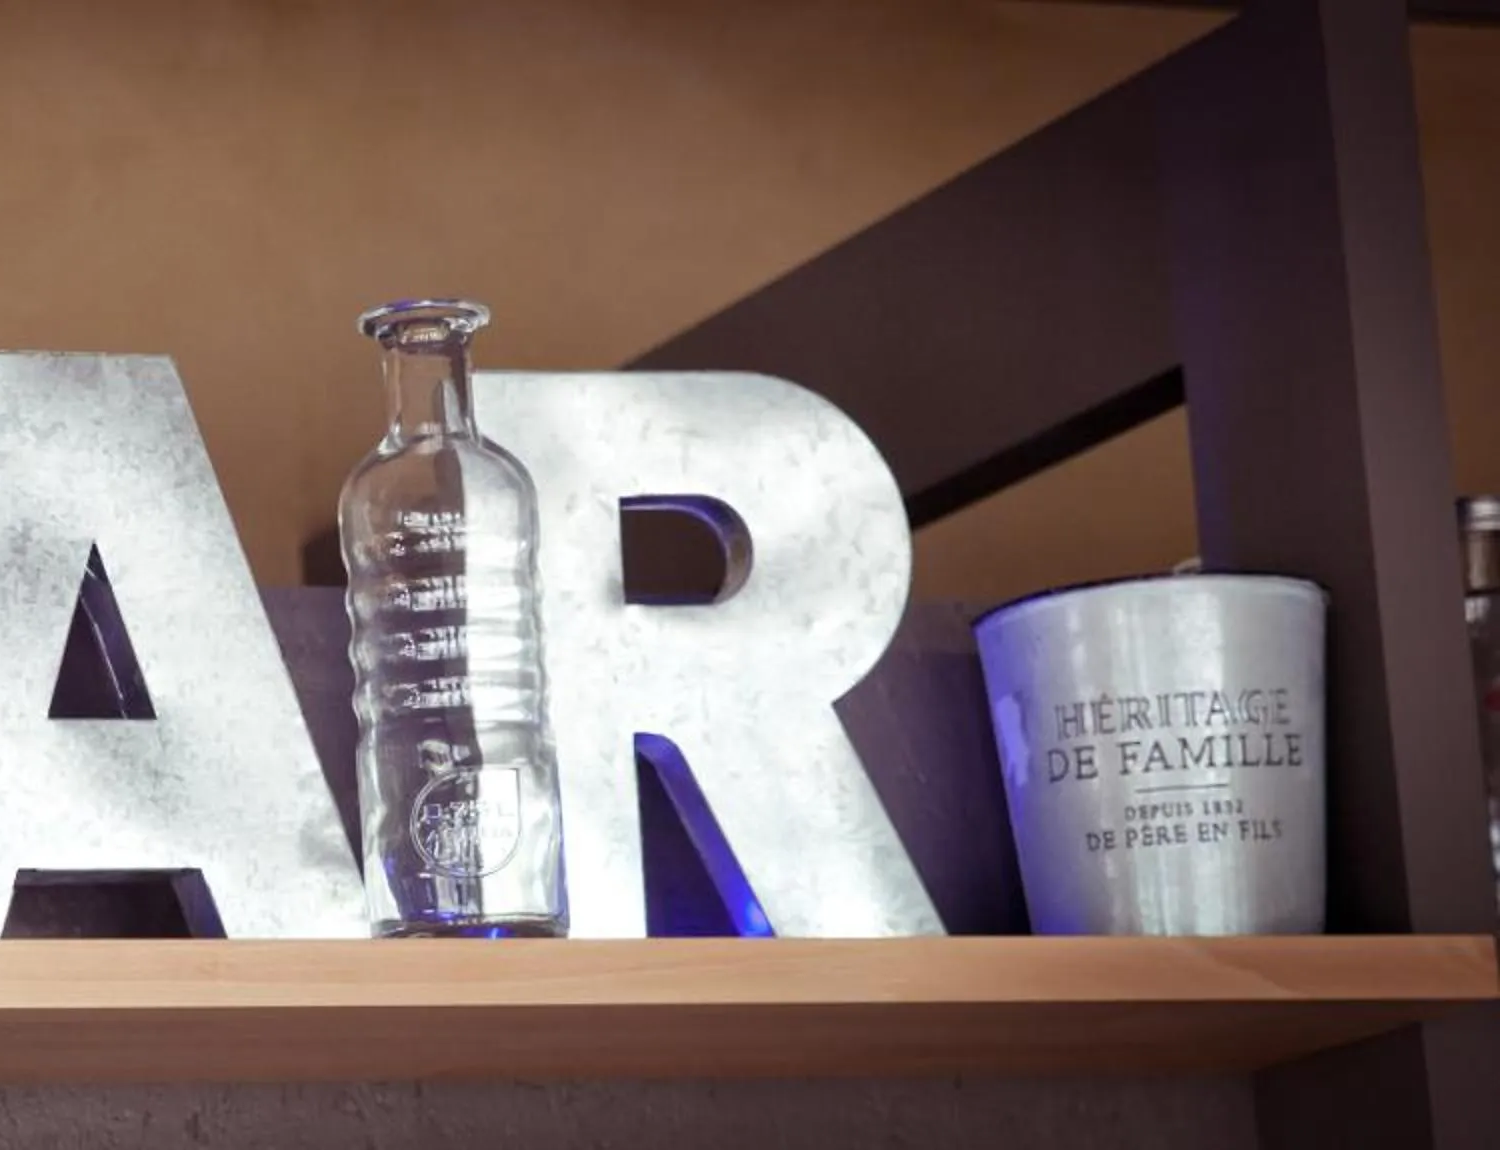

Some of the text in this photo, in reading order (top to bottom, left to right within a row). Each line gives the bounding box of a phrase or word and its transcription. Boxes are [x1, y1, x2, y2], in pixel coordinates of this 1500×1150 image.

[1054, 688, 1291, 740] HÉRITAGE
[1048, 732, 1304, 784] DE FAMILLE
[1124, 802, 1194, 822] DEPUIS
[1085, 817, 1283, 852] DE PÈRE EN FILS
